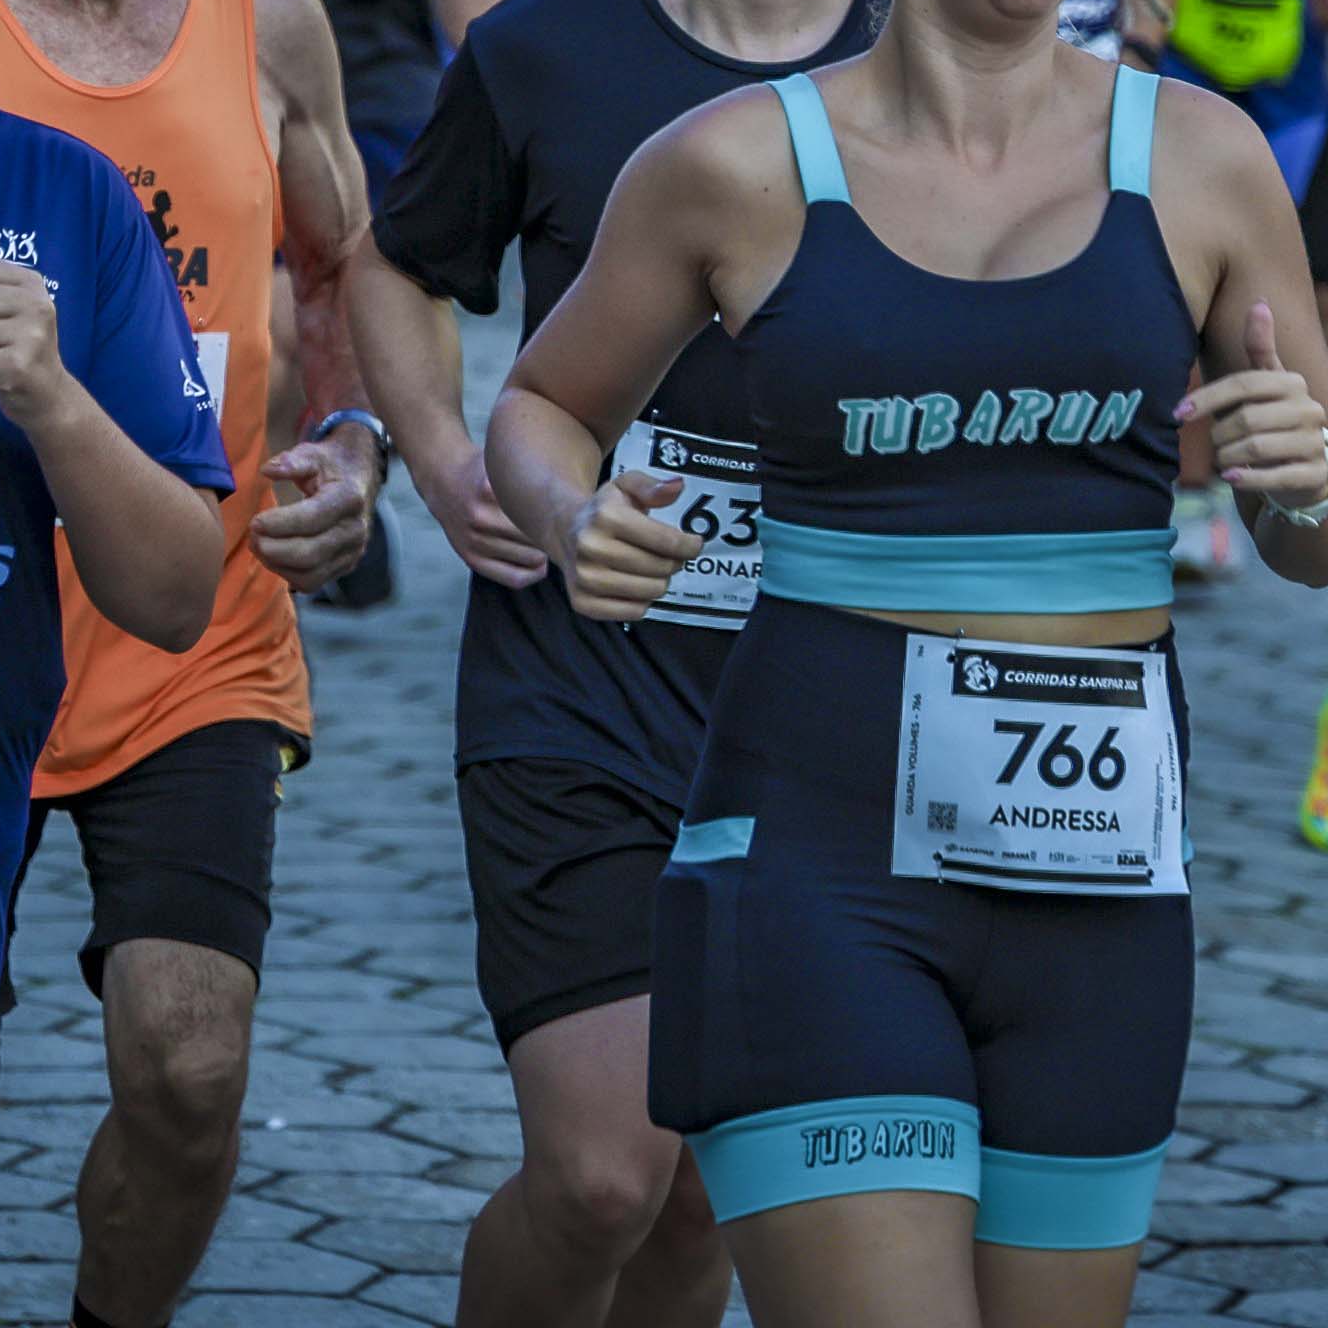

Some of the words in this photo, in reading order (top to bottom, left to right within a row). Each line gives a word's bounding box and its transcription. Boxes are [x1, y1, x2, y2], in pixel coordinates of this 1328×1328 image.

[837, 388, 1143, 456] TUBARUN
[691, 453, 756, 471] CORRIDAS
[680, 556, 763, 579] EONAR
[1004, 670, 1077, 687] CORRIDAS
[1079, 675, 1124, 690] SANEPAR
[993, 719, 1127, 791] 766
[989, 804, 1121, 833] ANDRESSA
[799, 1119, 955, 1169] TUBARUN
